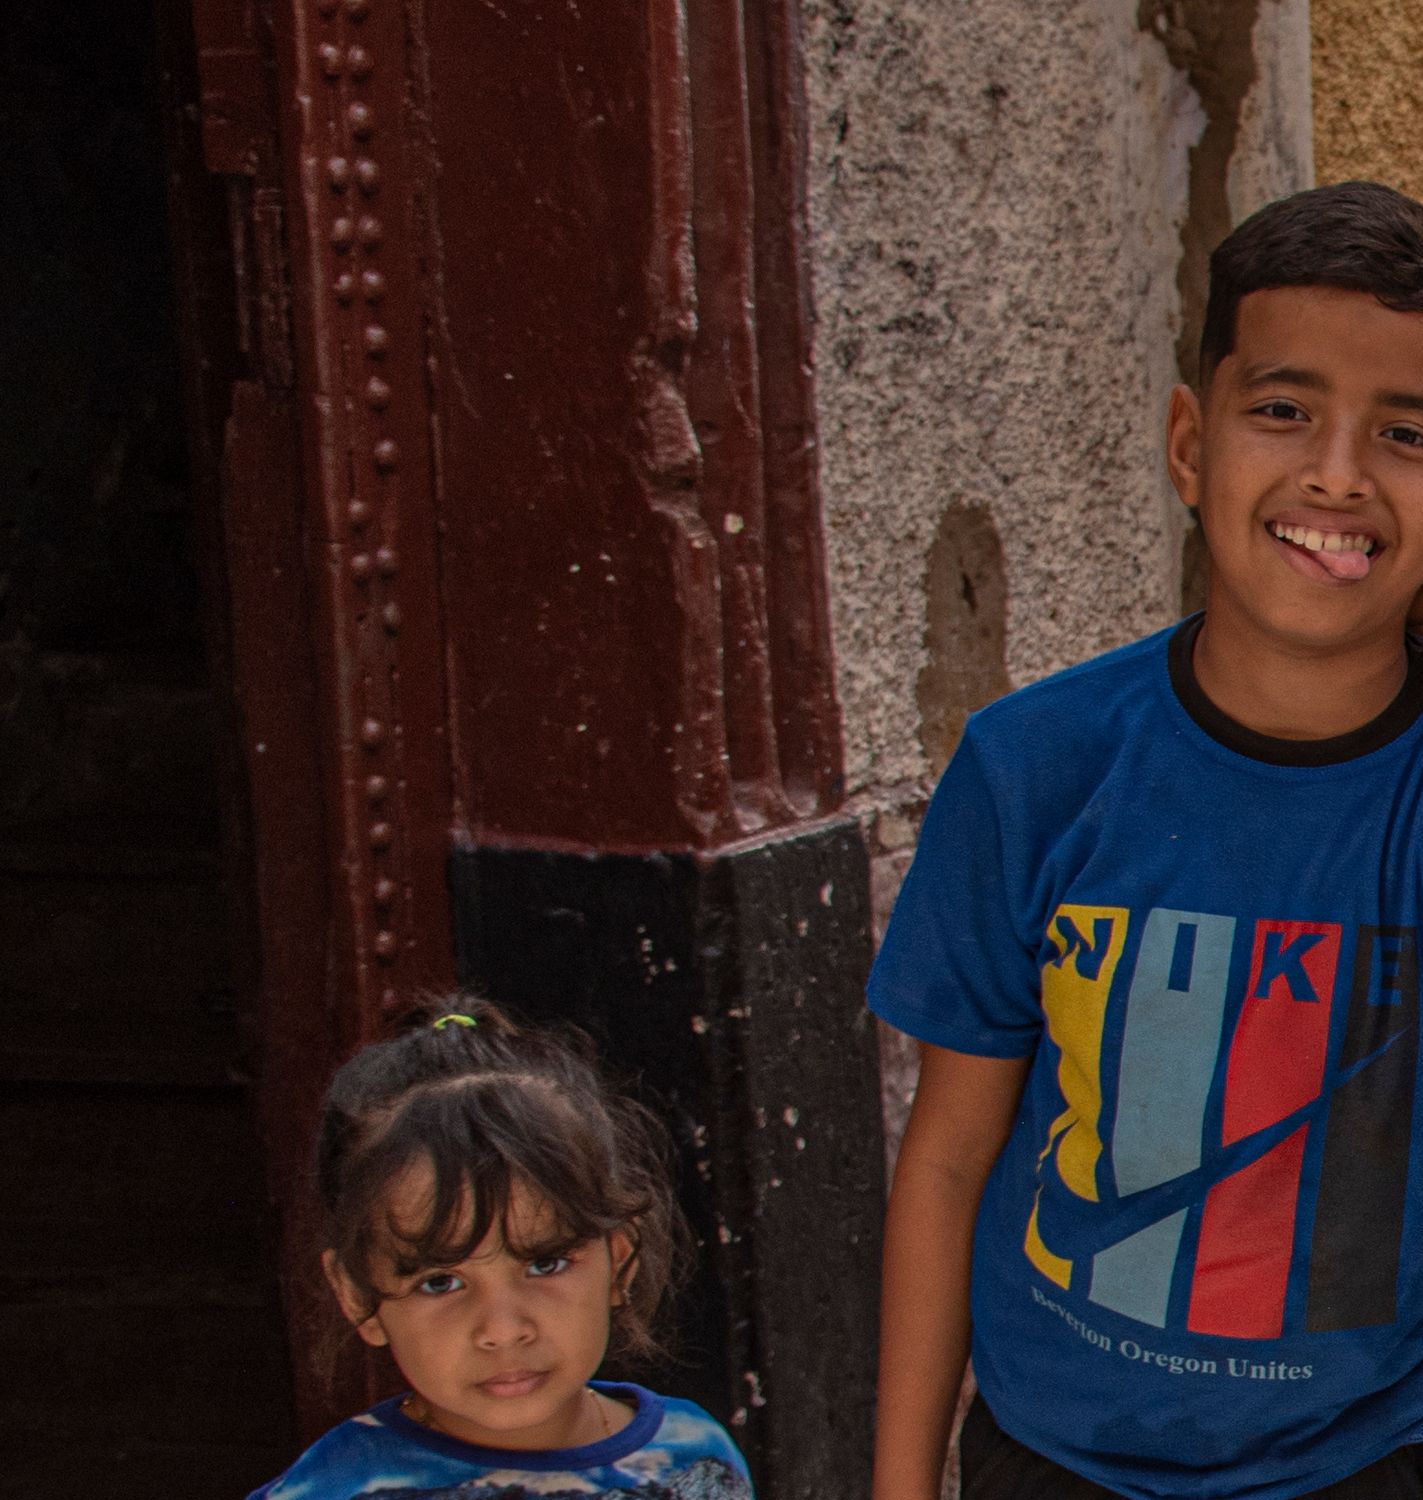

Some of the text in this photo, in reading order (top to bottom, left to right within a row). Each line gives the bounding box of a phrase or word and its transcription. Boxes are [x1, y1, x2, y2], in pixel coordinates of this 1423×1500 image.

[1038, 914, 1412, 1006] NIKE
[1119, 1340, 1217, 1374] Oregon
[1226, 1358, 1314, 1380] Unites
